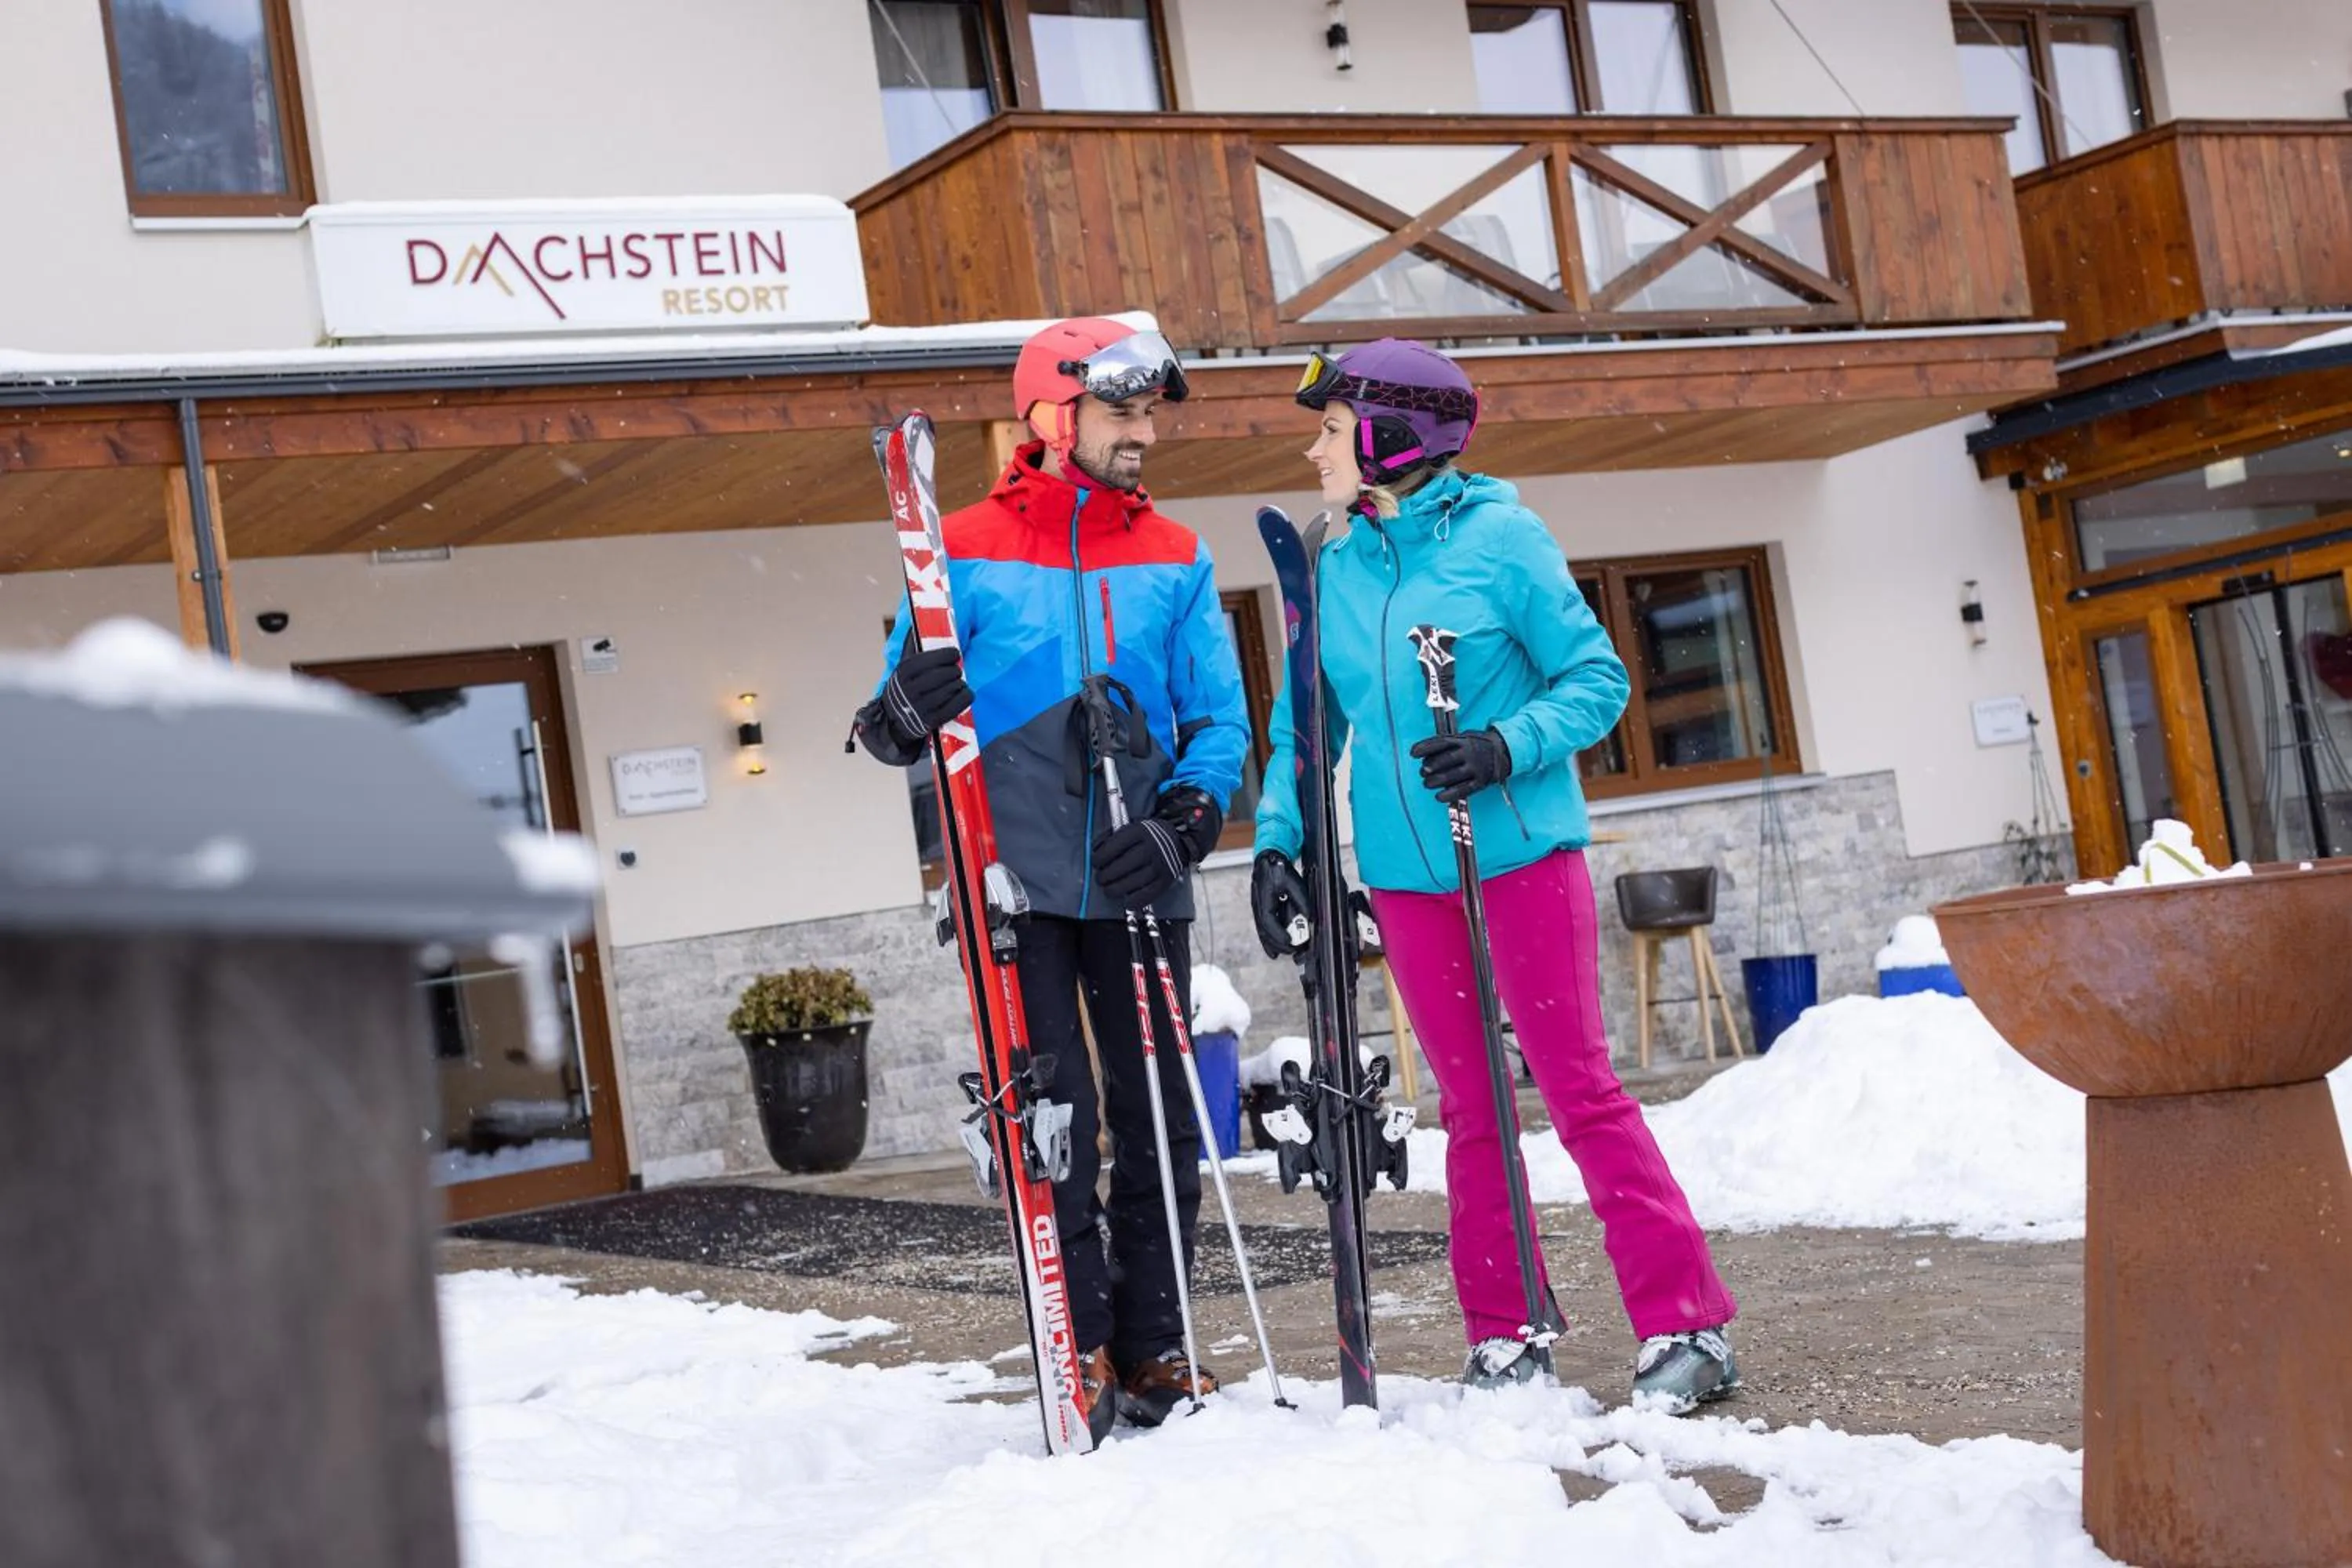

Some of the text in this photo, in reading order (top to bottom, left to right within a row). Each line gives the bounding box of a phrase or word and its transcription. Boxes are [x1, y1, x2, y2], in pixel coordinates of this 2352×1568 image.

[406, 230, 789, 319] DACHSTEIN
[662, 285, 789, 316] RESORT
[1447, 808, 1463, 844] EKI
[1032, 1214, 1076, 1399] UNLIMITED
